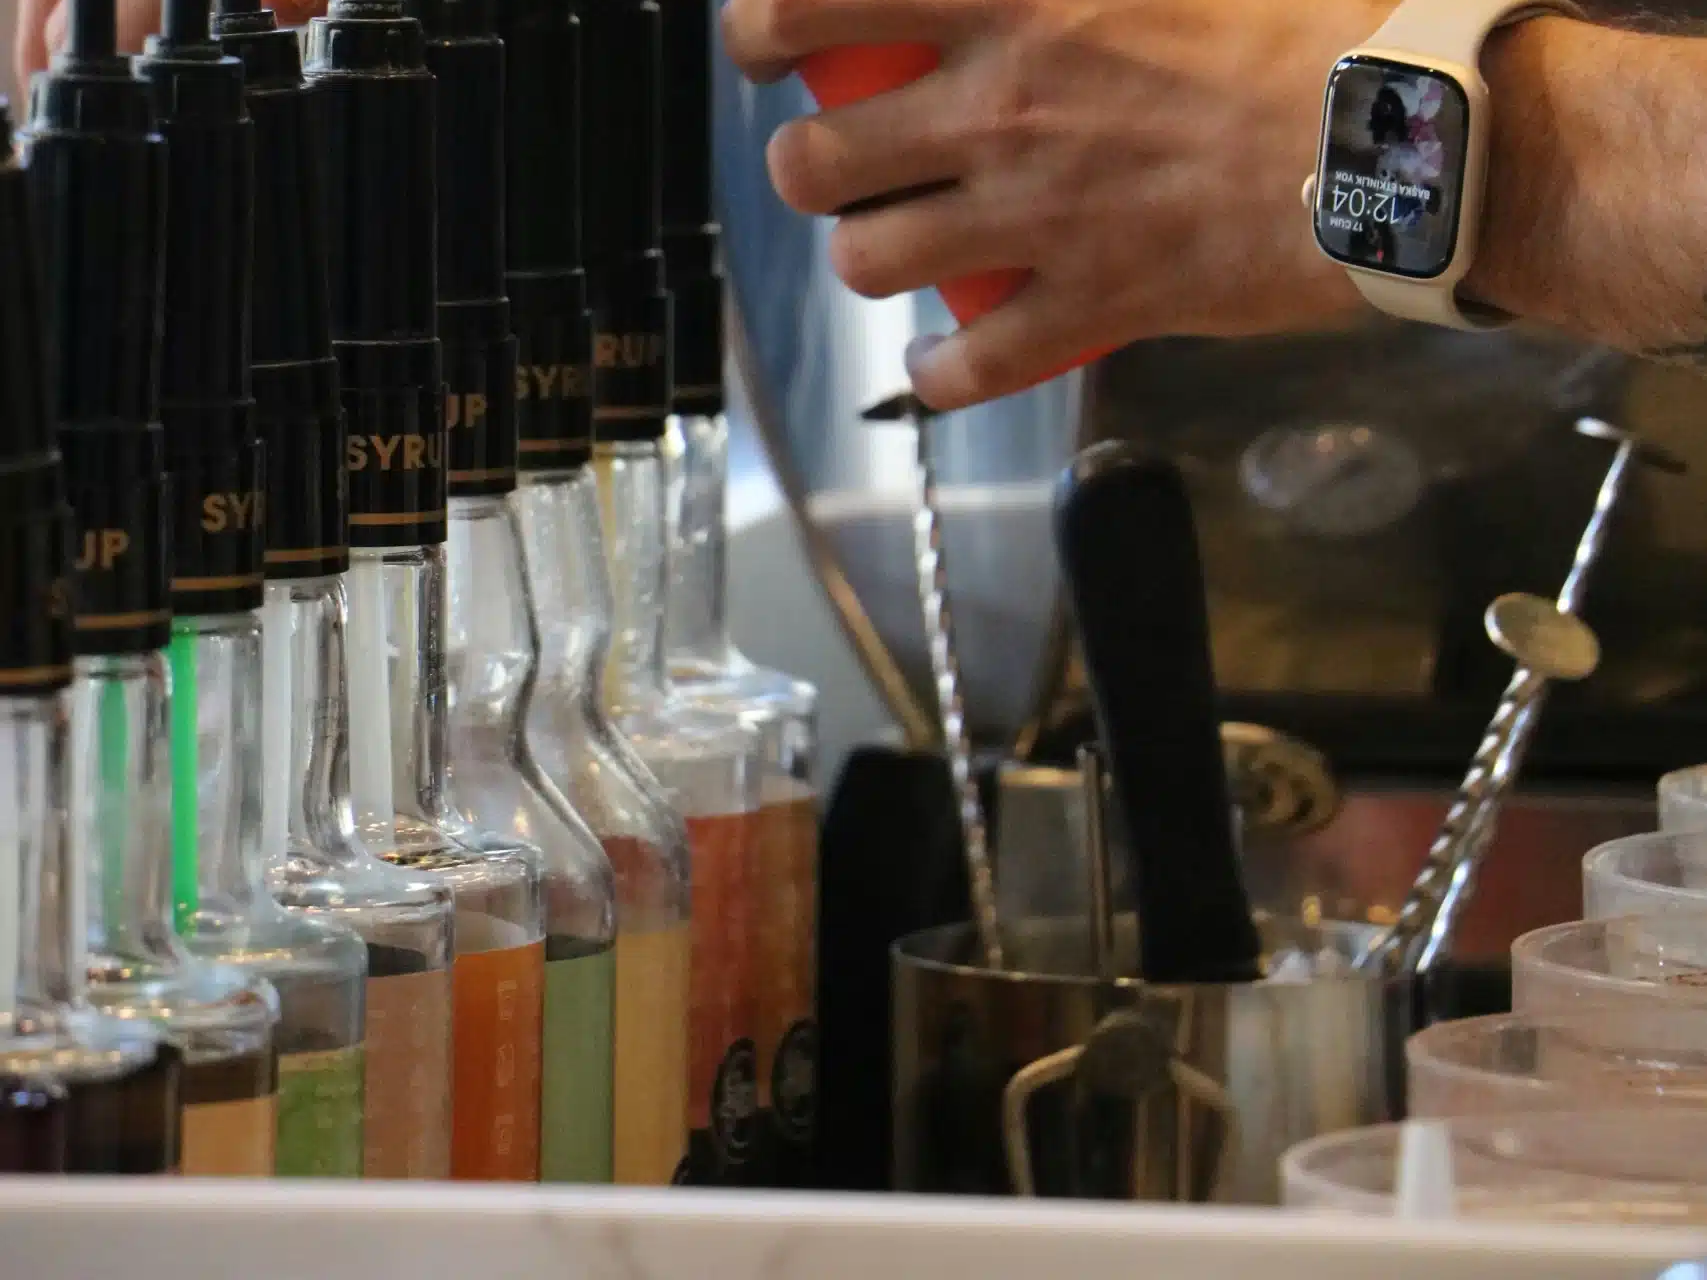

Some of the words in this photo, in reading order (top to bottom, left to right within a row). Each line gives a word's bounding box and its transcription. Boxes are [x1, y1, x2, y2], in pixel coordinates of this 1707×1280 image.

[1335, 170, 1354, 182] YOK
[1399, 183, 1431, 200] BAŞKA
[1331, 185, 1399, 225] 12:04
[1330, 216, 1351, 231] CUM
[1352, 221, 1363, 232] 17
